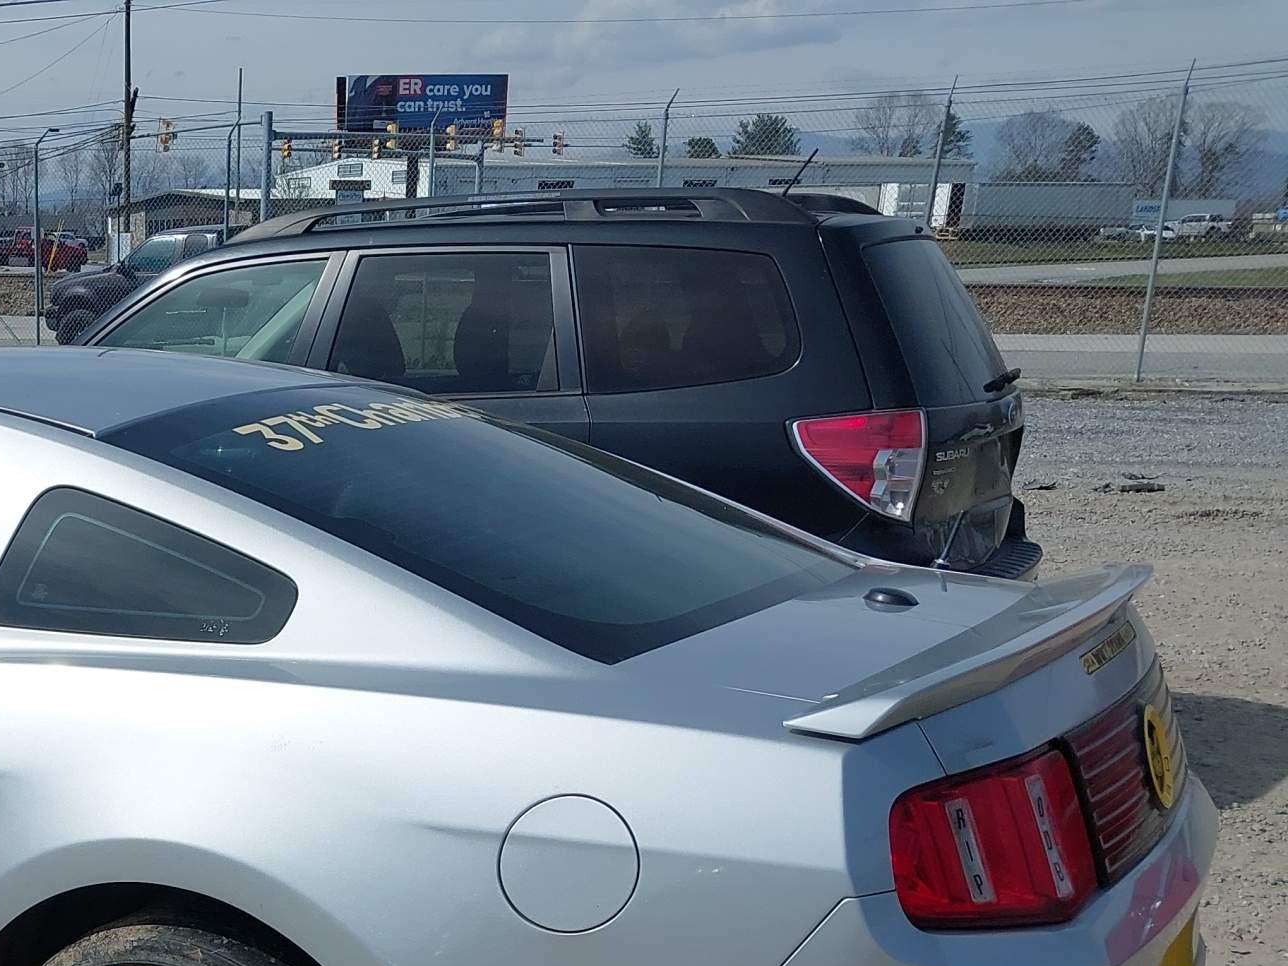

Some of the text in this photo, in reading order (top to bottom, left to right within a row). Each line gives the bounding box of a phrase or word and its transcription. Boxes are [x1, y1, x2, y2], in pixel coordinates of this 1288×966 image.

[399, 78, 491, 99] ER care you
[396, 98, 466, 112] can trust.
[935, 447, 970, 462] SUBARU
[955, 808, 984, 895] RIP
